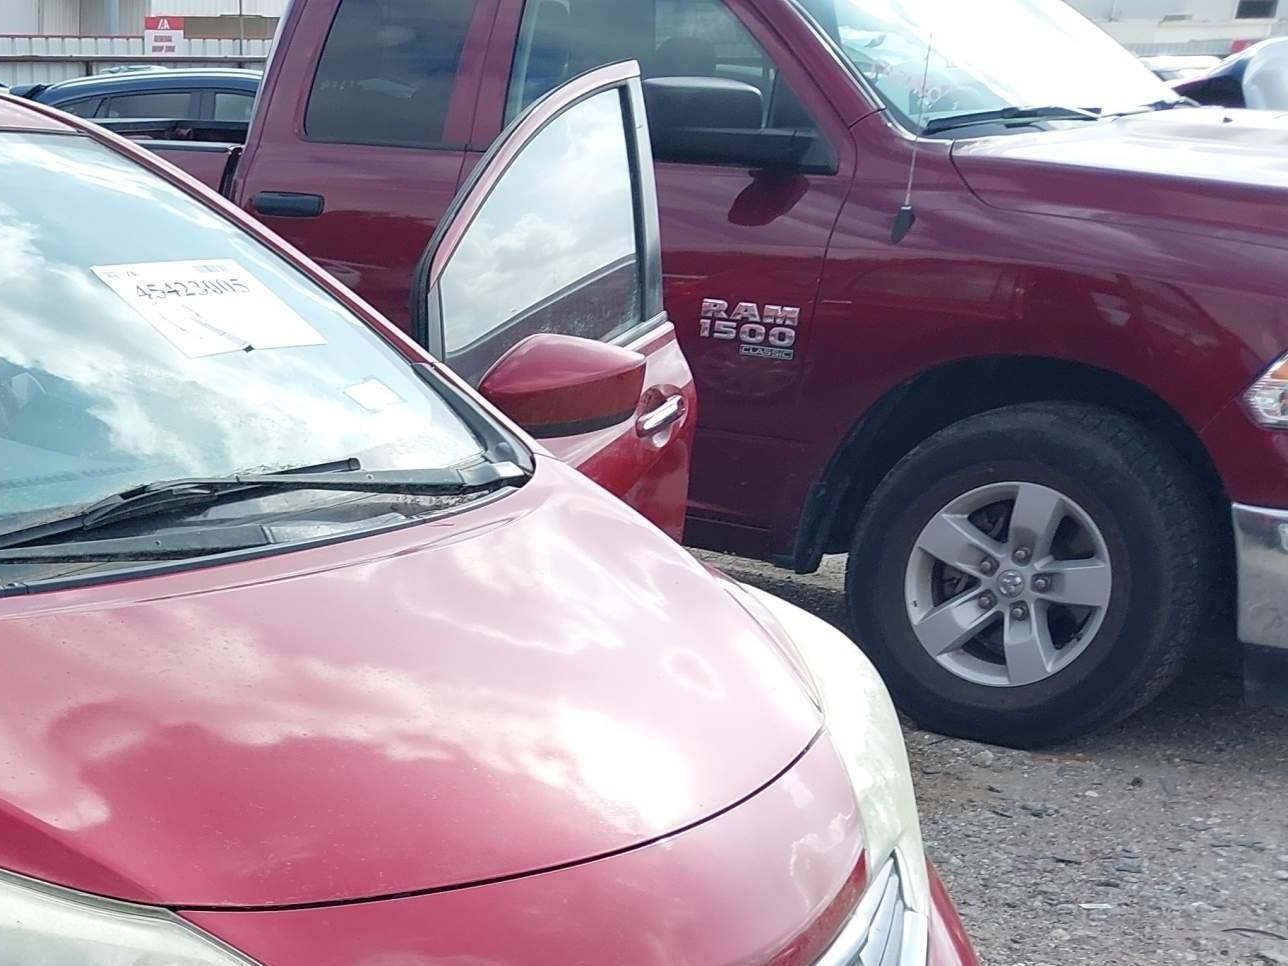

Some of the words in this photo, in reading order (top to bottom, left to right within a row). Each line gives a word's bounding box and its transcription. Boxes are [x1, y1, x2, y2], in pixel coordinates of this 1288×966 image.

[135, 278, 251, 300] 45423005
[700, 298, 801, 326] RAM
[699, 318, 796, 347] 1500
[740, 345, 794, 360] CLASSIC
